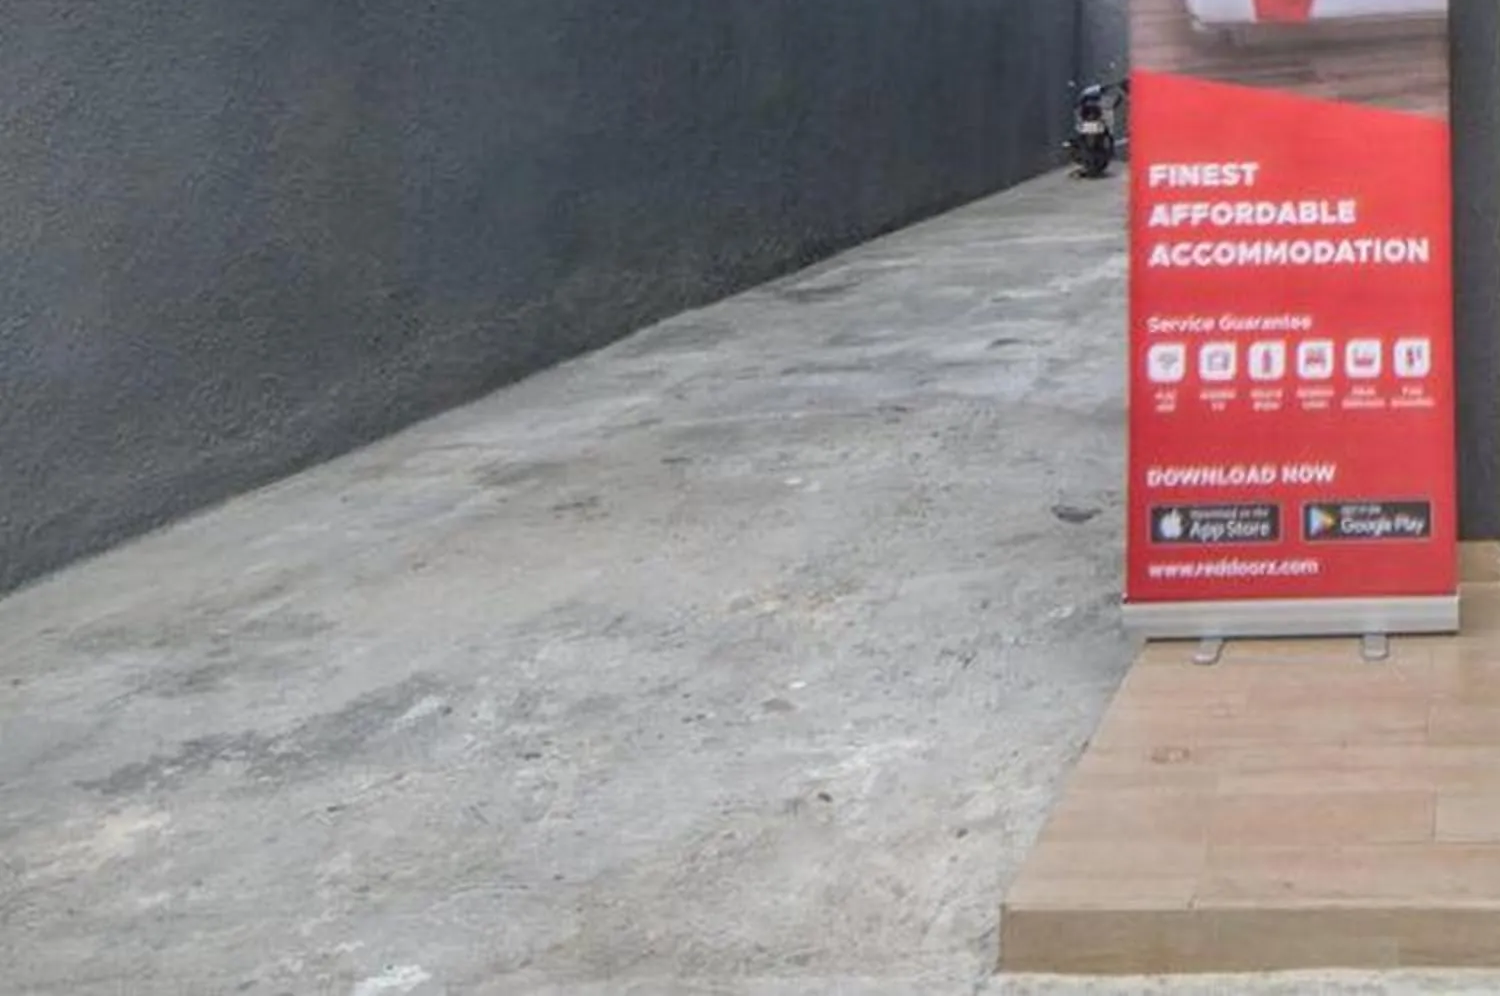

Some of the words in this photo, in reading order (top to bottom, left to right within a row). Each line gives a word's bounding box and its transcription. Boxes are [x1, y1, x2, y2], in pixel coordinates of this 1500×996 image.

[1149, 162, 1259, 186] FINEST
[1148, 200, 1357, 227] AFFORDABLE
[1148, 238, 1430, 267] ACCOMMODATION
[1146, 314, 1215, 332] Service
[1218, 313, 1312, 331] Guarantee
[1147, 467, 1277, 486] DOWNLOAD
[1281, 464, 1337, 483] NOW
[1189, 521, 1225, 542] App
[1227, 520, 1270, 538] Store
[1341, 517, 1392, 536] Google
[1394, 514, 1425, 535] Play
[1148, 558, 1319, 578] www.reddoorz.com
